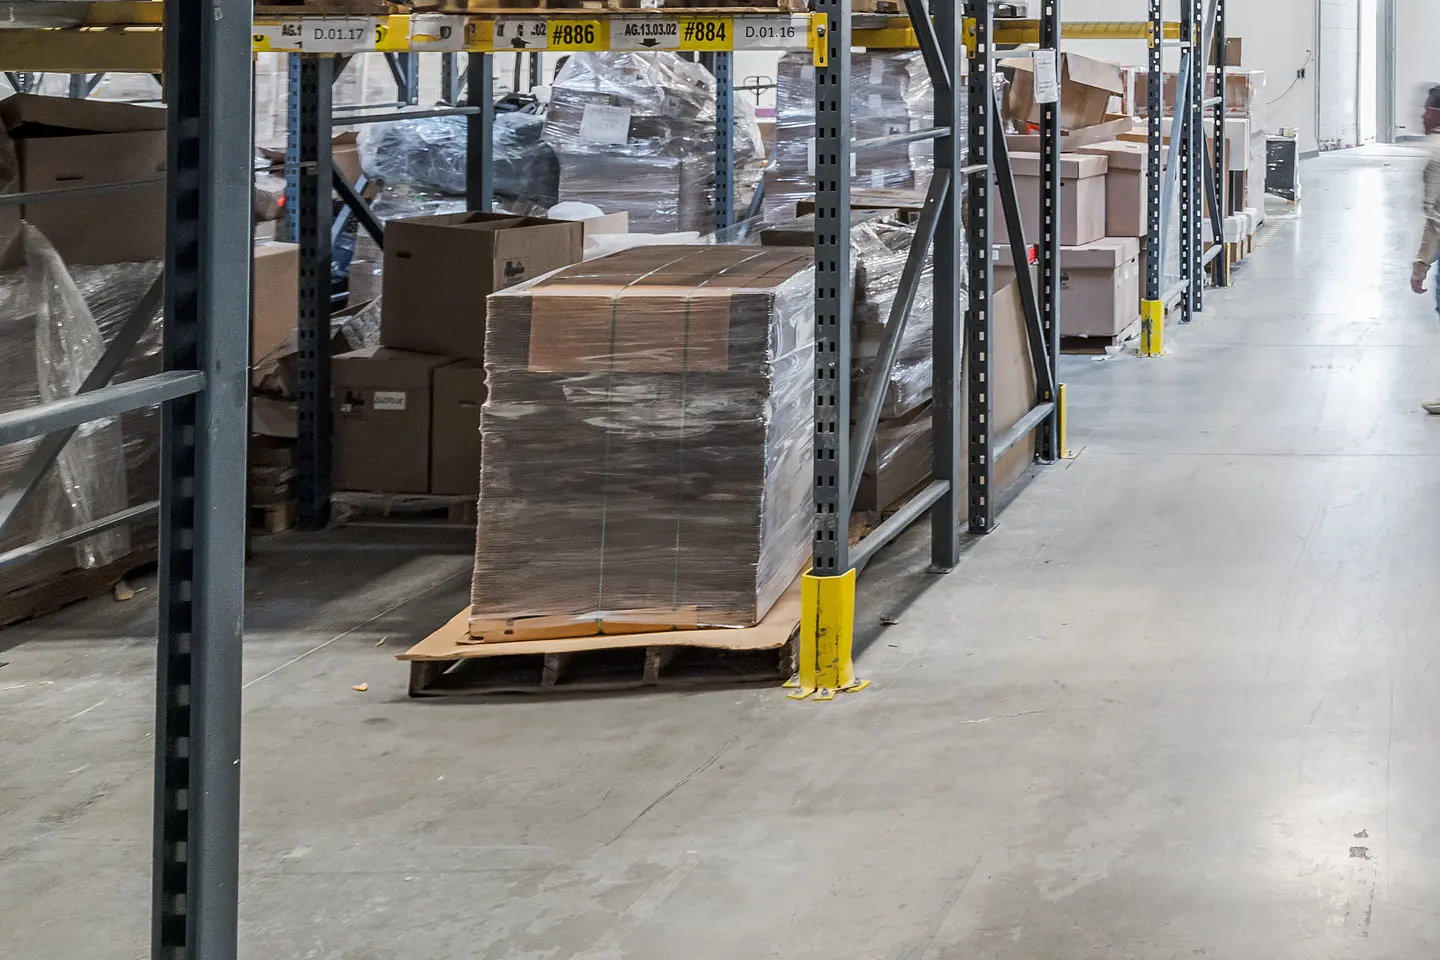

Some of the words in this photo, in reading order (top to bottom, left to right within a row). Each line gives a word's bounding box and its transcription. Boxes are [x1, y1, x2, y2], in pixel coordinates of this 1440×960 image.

[314, 28, 364, 40] D.01.17
[552, 23, 594, 44] #886
[624, 23, 677, 37] AG.13.03.02
[684, 22, 726, 42] #884
[746, 26, 795, 38] D.01.16
